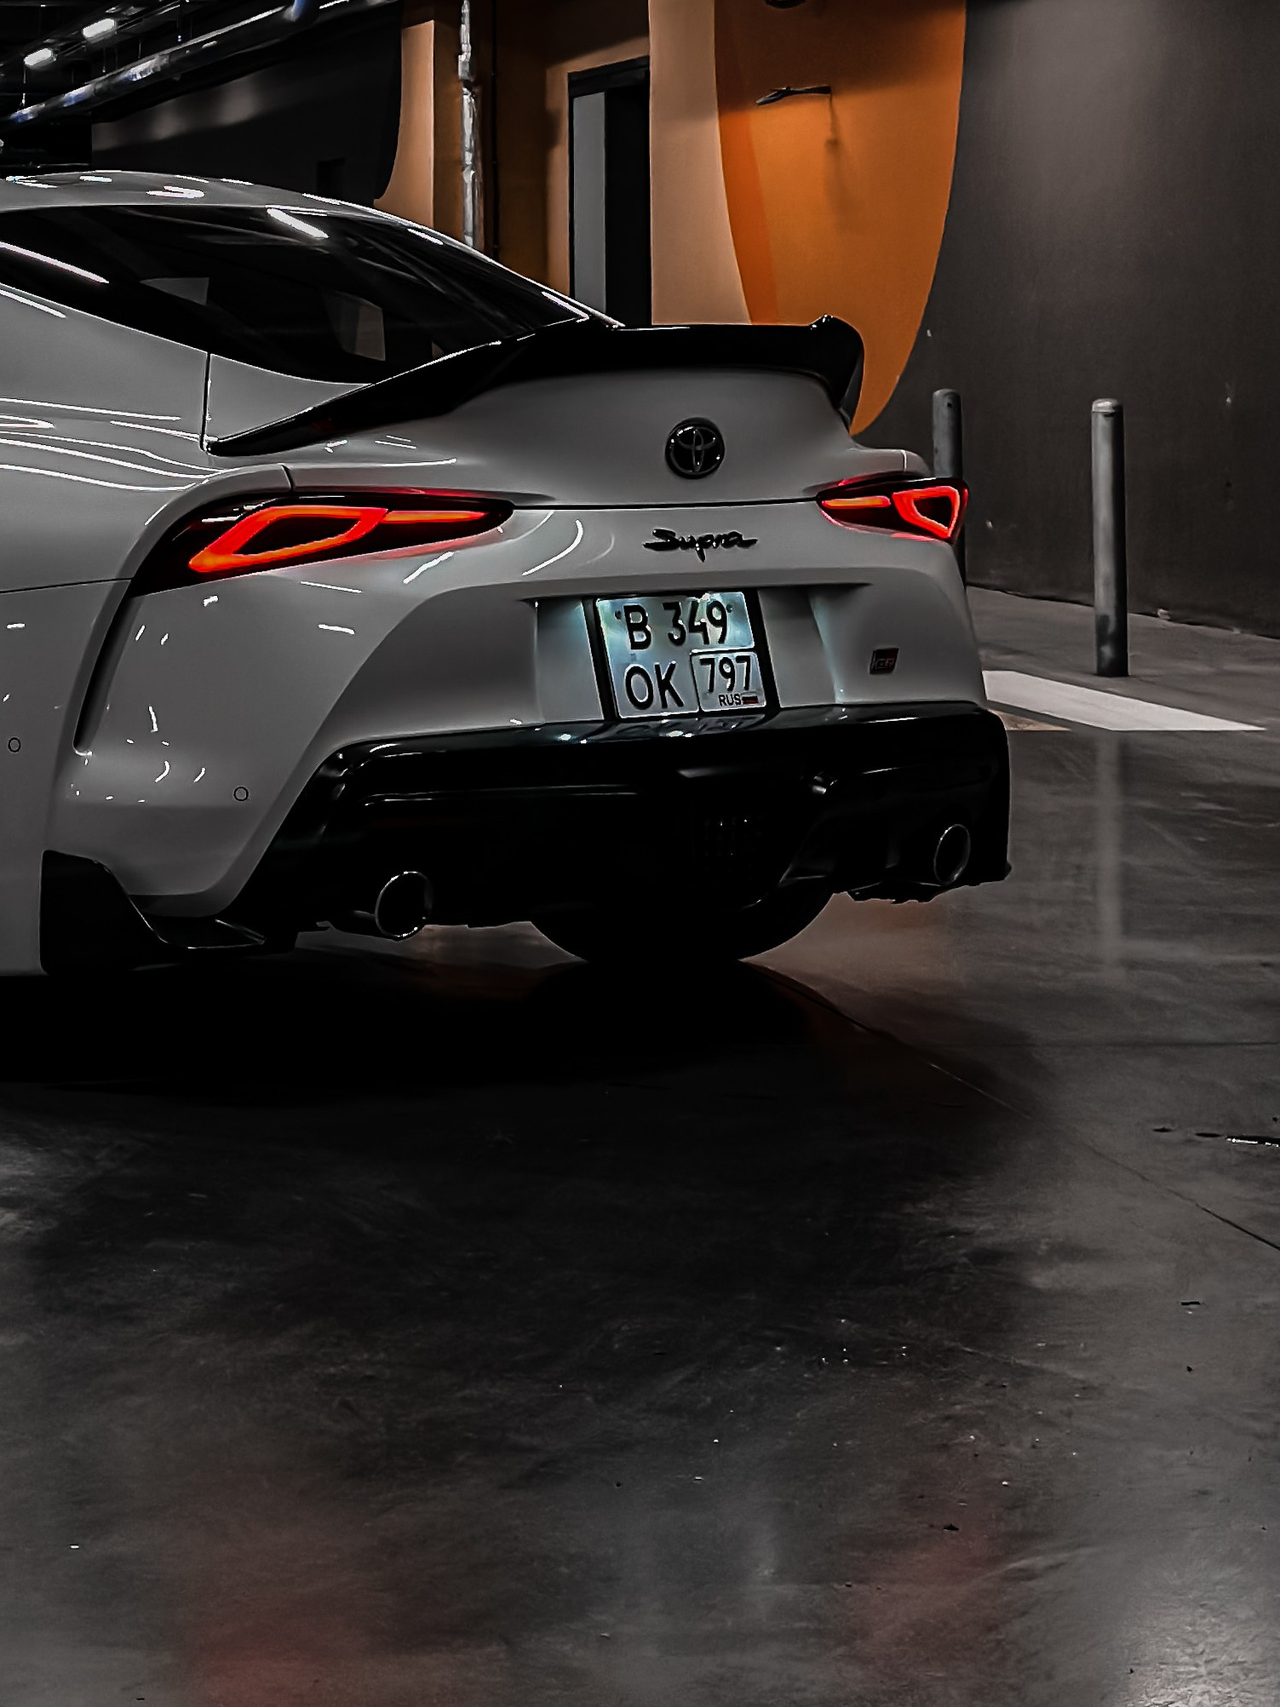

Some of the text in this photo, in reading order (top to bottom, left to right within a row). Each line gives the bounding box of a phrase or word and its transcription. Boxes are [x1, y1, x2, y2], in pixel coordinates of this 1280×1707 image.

[642, 528, 758, 562] Supra
[623, 600, 728, 650] B 349
[624, 661, 684, 711] OK
[699, 655, 752, 693] 797
[718, 693, 742, 707] RUS
